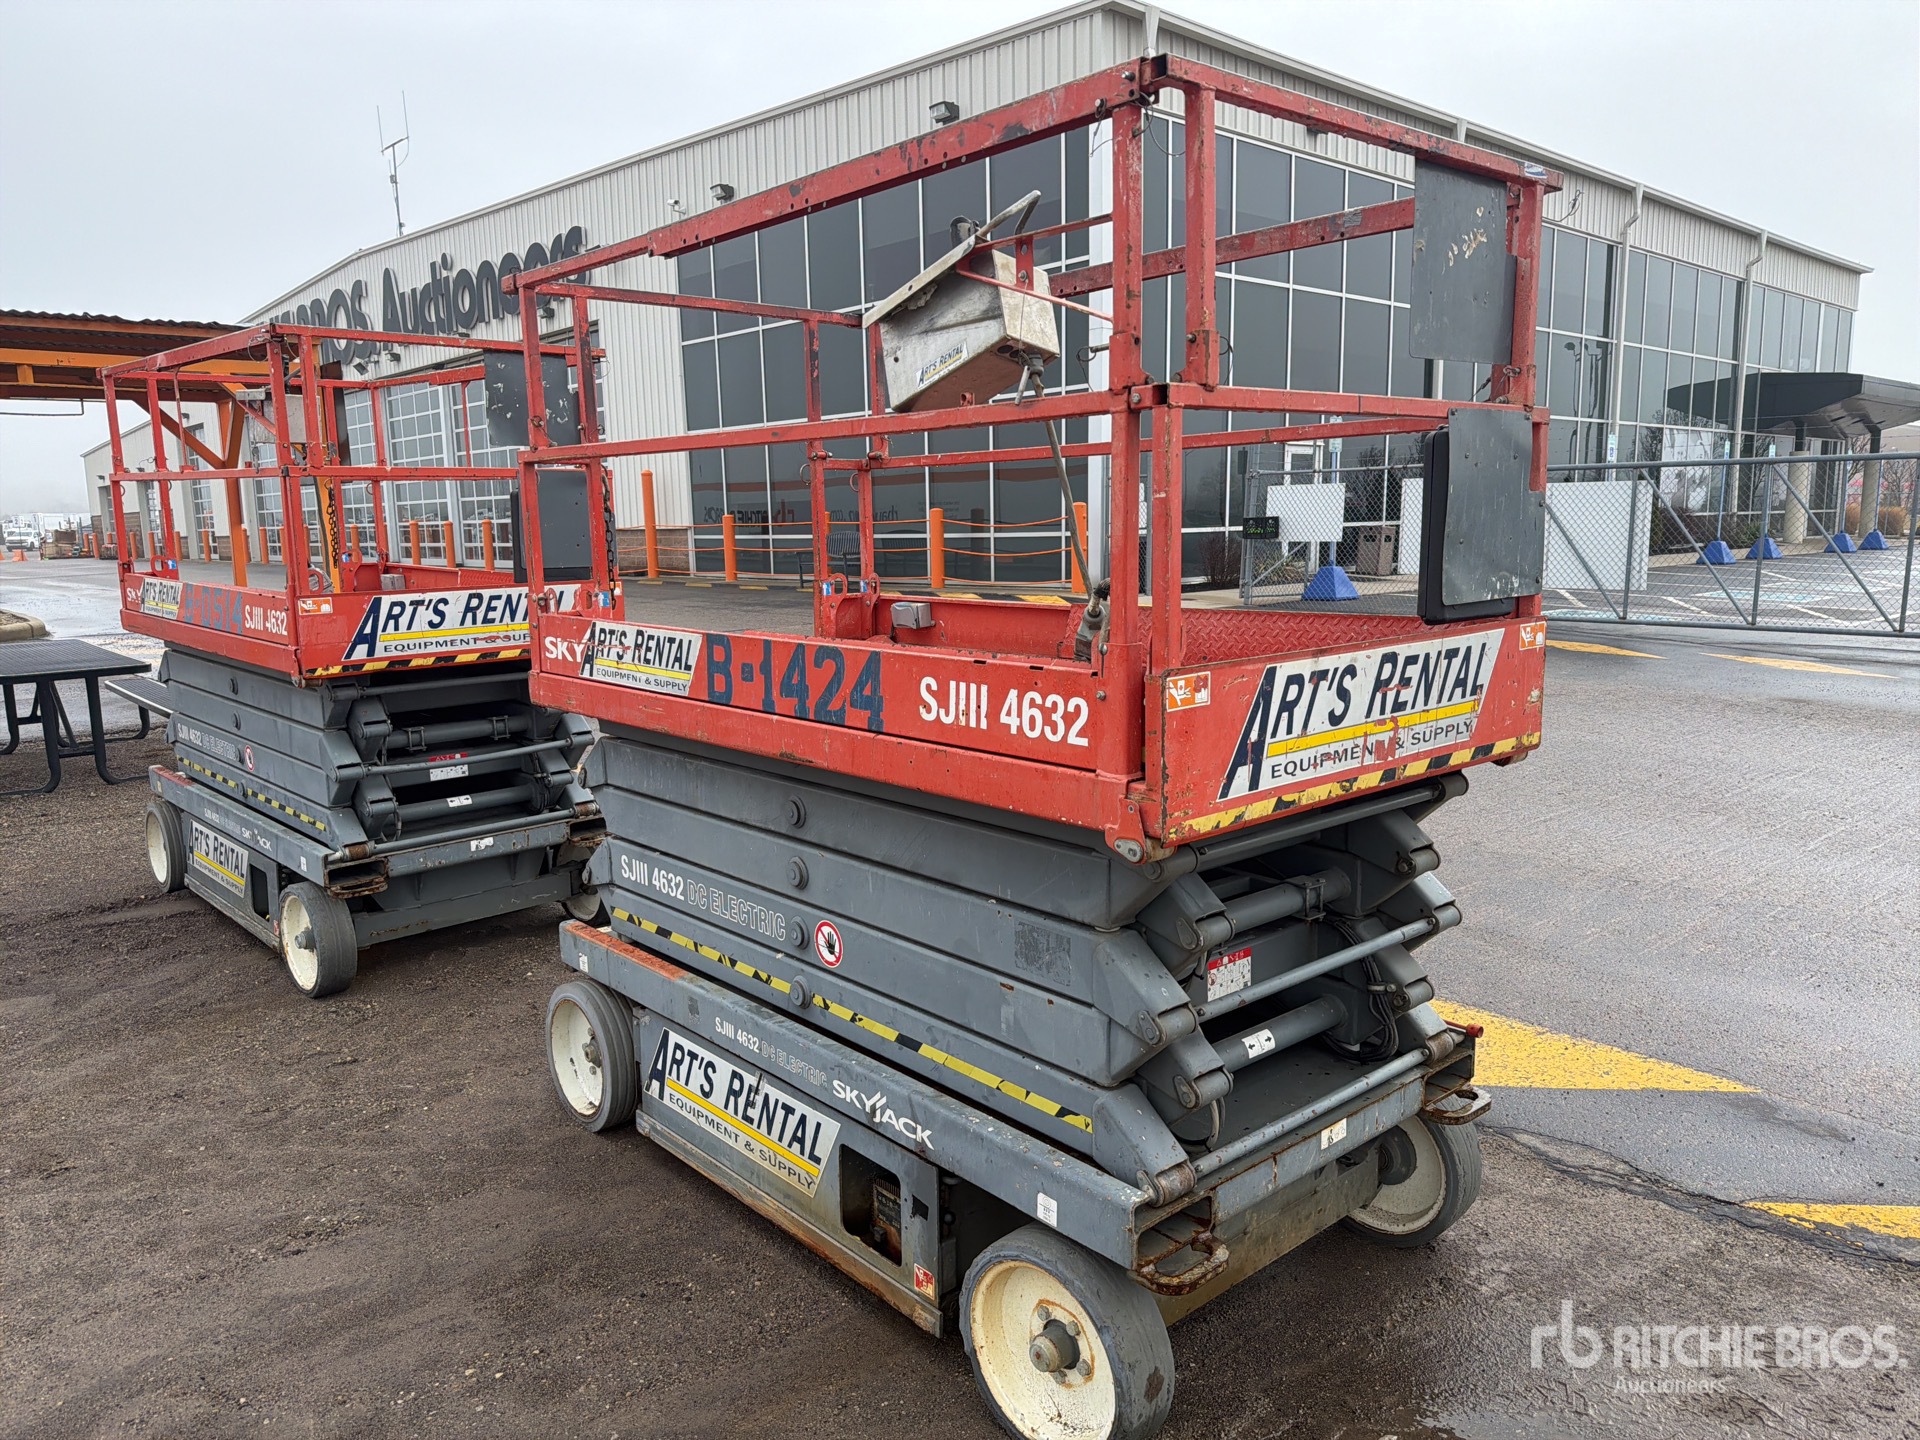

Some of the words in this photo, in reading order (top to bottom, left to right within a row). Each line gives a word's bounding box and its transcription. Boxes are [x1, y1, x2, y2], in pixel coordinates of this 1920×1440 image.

[158, 582, 180, 605] RENTAL
[266, 609, 288, 636] 4632
[344, 597, 449, 660] ART'S
[384, 637, 478, 653] EQUIPMENT
[580, 622, 628, 677] ART'S
[632, 629, 693, 672] RENTAL
[597, 668, 643, 684] EQUIPMENT
[645, 677, 652, 685] &
[654, 679, 688, 692] SUPPLY
[920, 676, 988, 730] SJIII
[1000, 688, 1090, 747] 4632
[1219, 662, 1358, 799] ART'S
[1365, 642, 1487, 719] RENTAL
[1271, 742, 1375, 779] EQUIPMEN
[1411, 720, 1473, 746] SUPPLY
[188, 821, 210, 864] ART'S
[213, 836, 244, 878] RENTAL
[195, 859, 220, 879] EQUIPMENT
[225, 878, 243, 894] SUPPLY
[621, 855, 648, 886] SJIII
[651, 866, 685, 900] 4632
[687, 879, 707, 909] DC
[709, 888, 786, 941] ELECTRIC
[736, 1029, 760, 1054] 4632
[761, 1040, 776, 1062] DC
[777, 1049, 828, 1087] ELECTRIC
[645, 1030, 717, 1102] ART'S
[724, 1069, 823, 1166] RENTAL
[832, 1075, 934, 1150] SKYJACK
[669, 1093, 740, 1144] EQUIPMENT
[744, 1140, 756, 1155] &
[758, 1149, 817, 1191] SUPPLY
